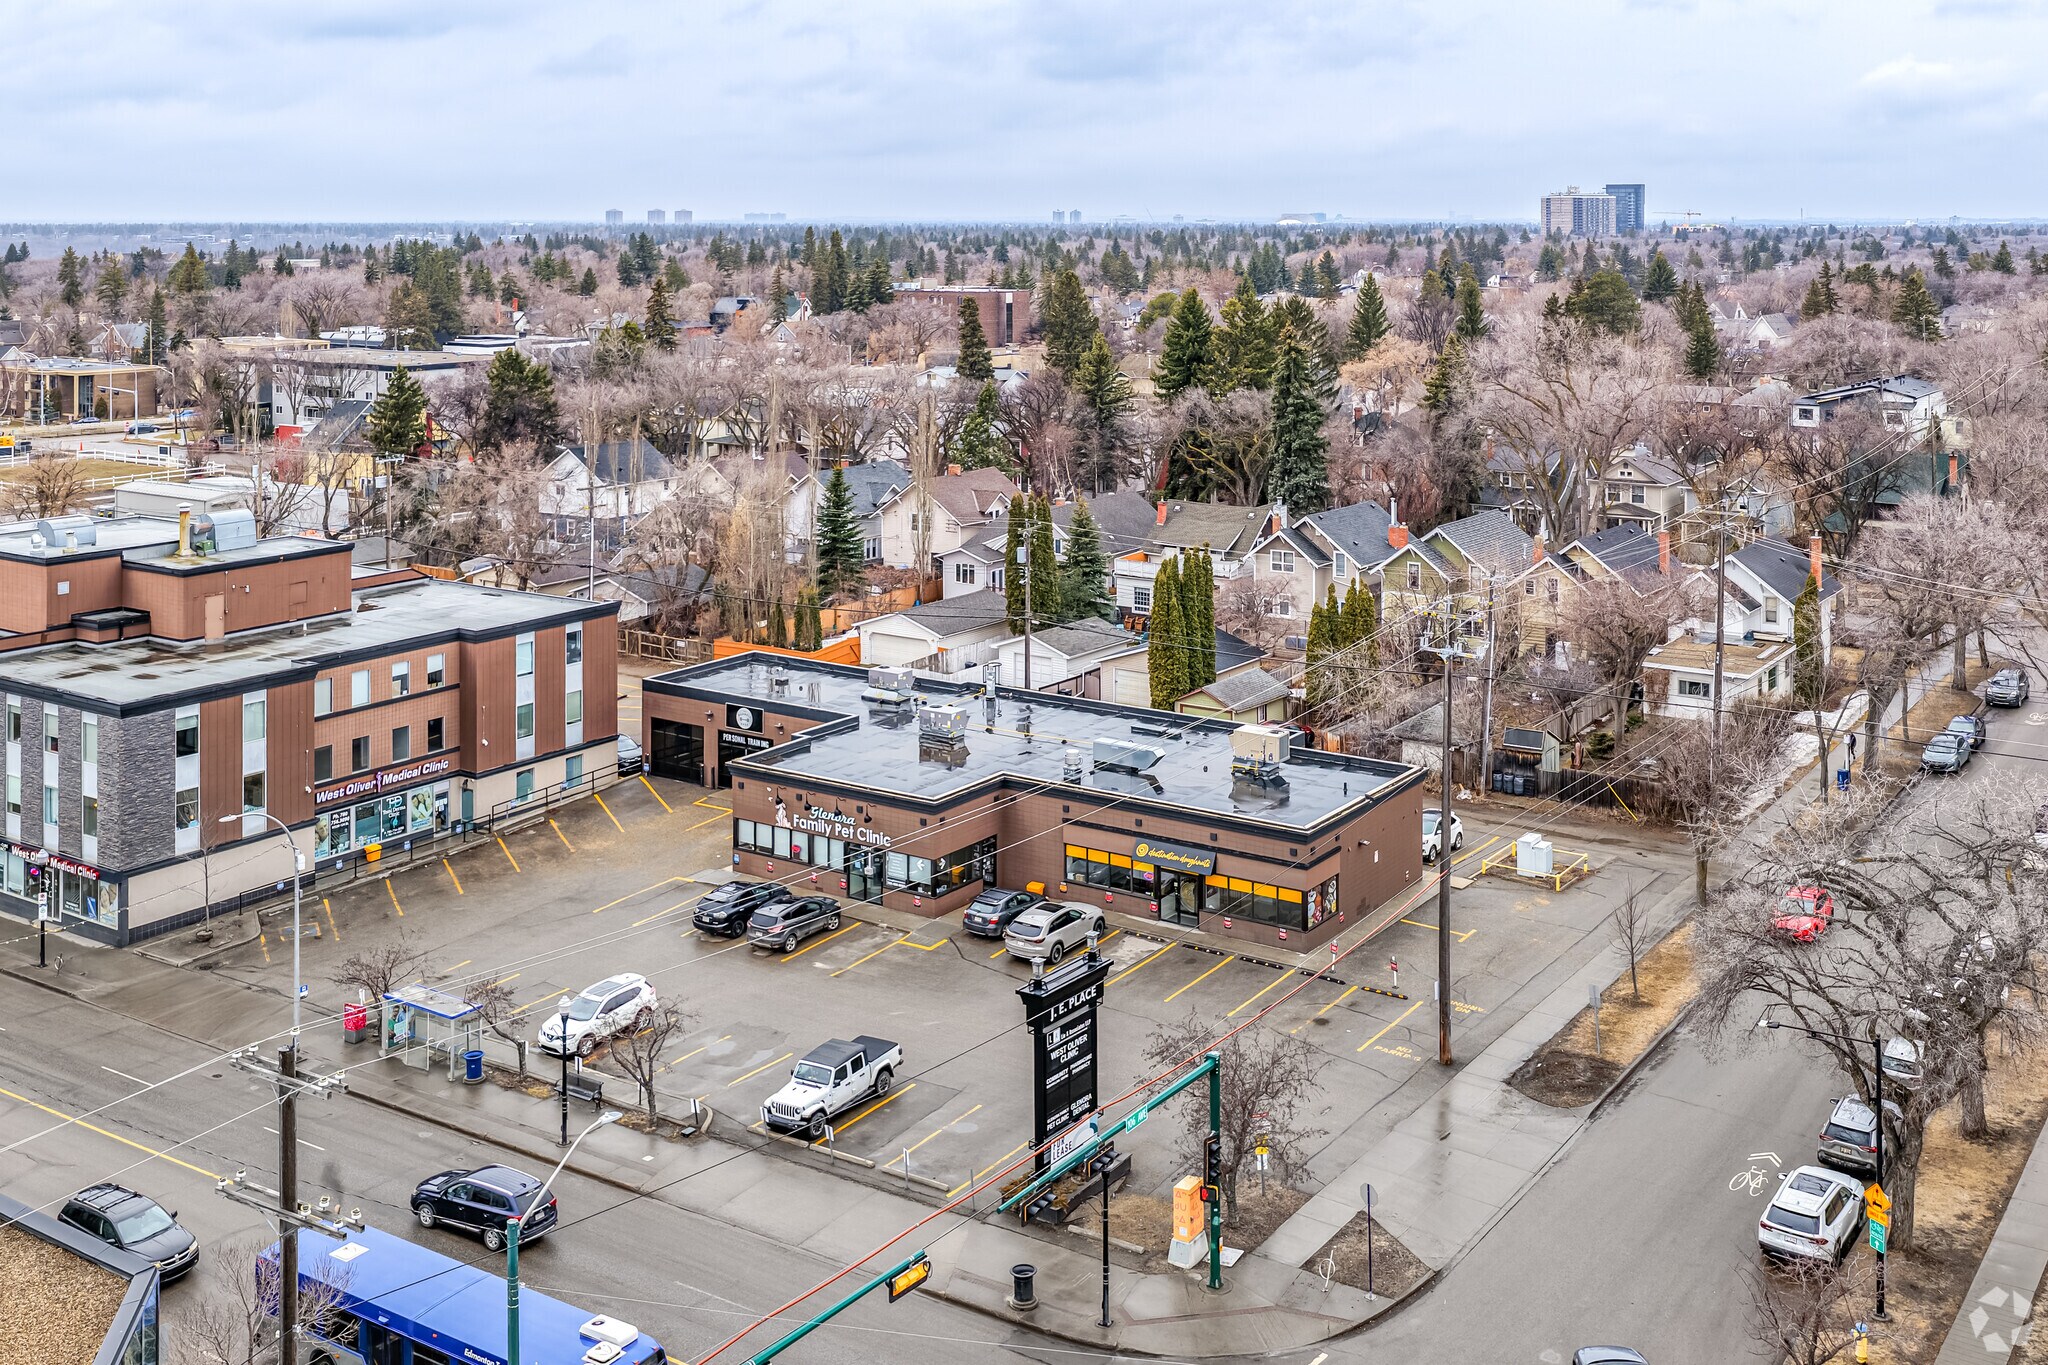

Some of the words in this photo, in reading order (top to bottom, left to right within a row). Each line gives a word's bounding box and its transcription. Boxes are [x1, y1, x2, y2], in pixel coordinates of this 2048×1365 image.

[316, 788, 345, 804] West
[345, 780, 376, 797] Oliver
[382, 765, 421, 786] Medical
[422, 760, 449, 774] Clinic
[809, 806, 856, 826] Glenora
[793, 814, 832, 837] Family
[835, 822, 854, 839] Pet
[857, 827, 891, 847] Clinic
[11, 845, 29, 859] West
[50, 857, 77, 875] Medical
[77, 866, 97, 880] Clinic
[1148, 847, 1180, 861] destination
[1180, 853, 1211, 868] doughnuts
[1050, 1008, 1057, 1022] J.
[1059, 1002, 1067, 1014] E.
[1069, 985, 1097, 1009] PLACE
[1050, 1045, 1067, 1060] WEST
[1067, 1034, 1088, 1051] OLIVER
[1060, 1047, 1079, 1064] CLINIC
[1070, 1093, 1093, 1111] GLENORA
[1053, 1140, 1072, 1160] LEASE
[464, 1347, 495, 1365] Edmonton
